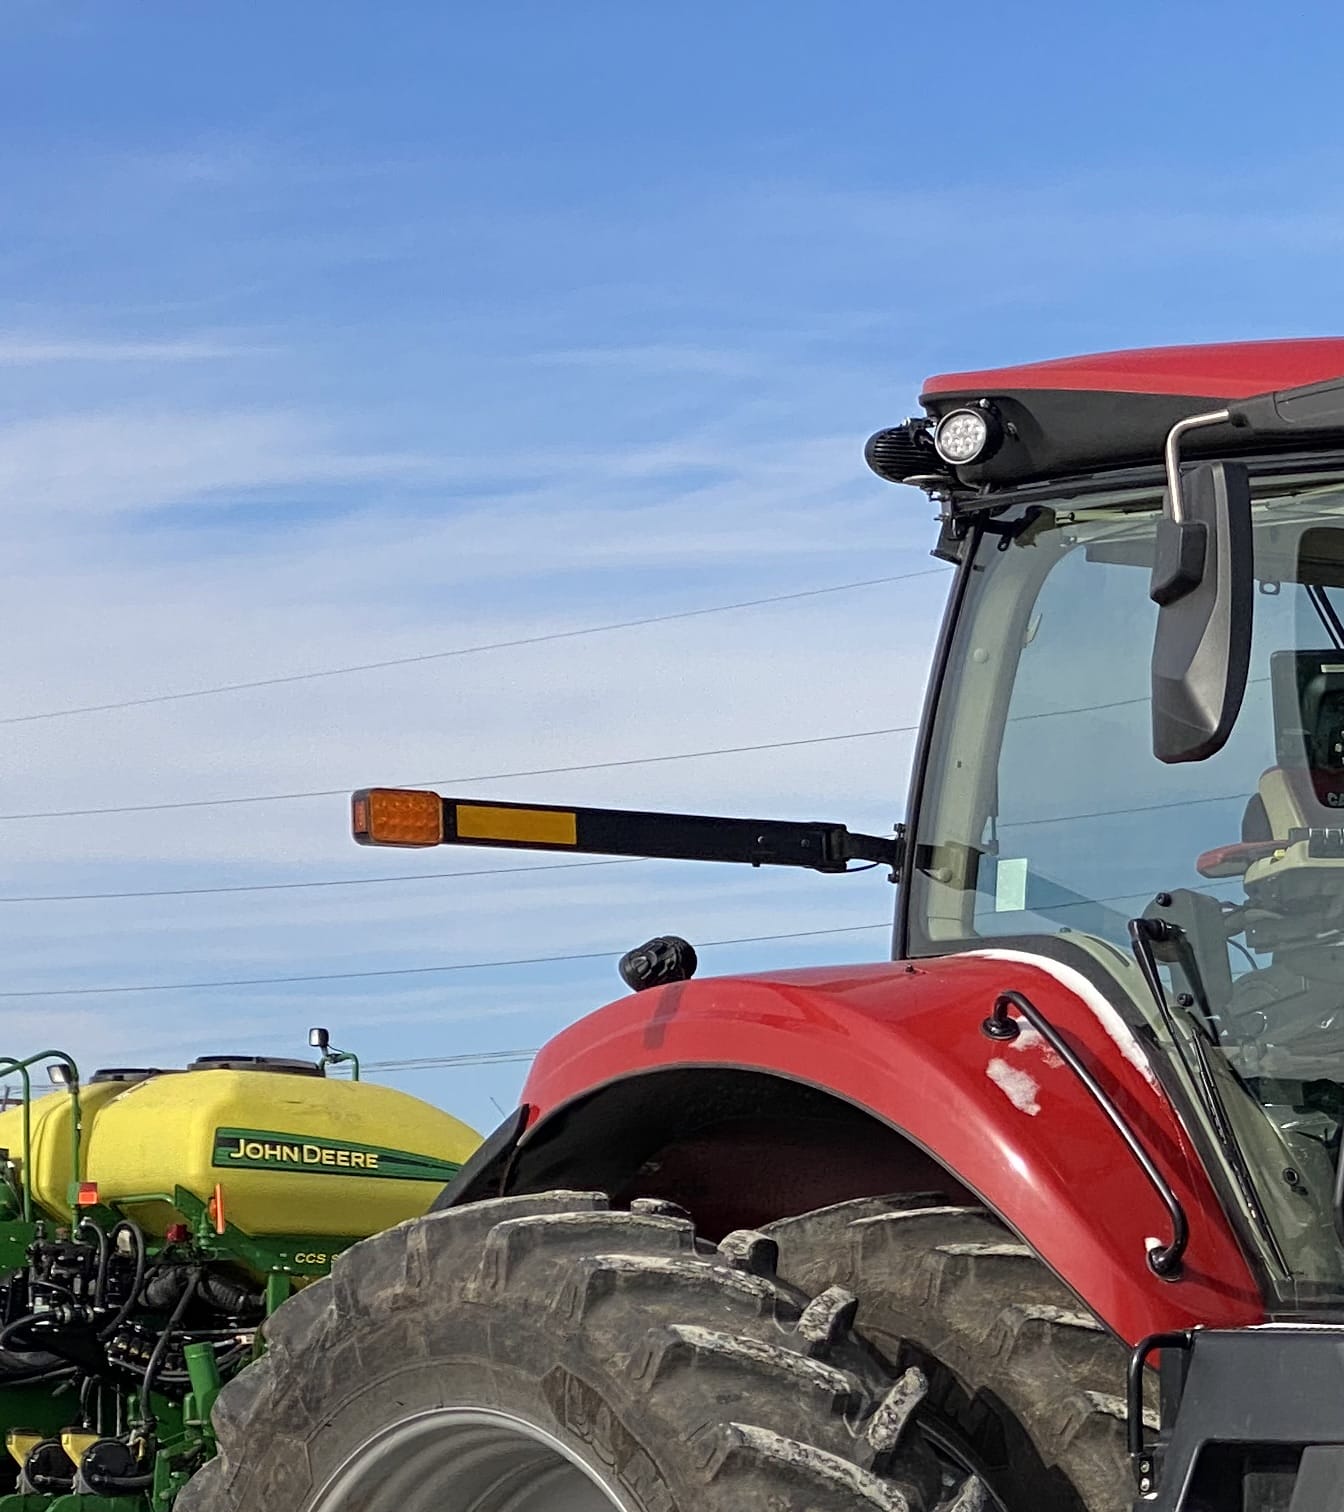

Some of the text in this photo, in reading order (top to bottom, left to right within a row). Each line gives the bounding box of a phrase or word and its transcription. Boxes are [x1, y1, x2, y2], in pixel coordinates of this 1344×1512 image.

[230, 1138, 379, 1169] JOHN DEERE
[295, 1252, 327, 1264] CCS
